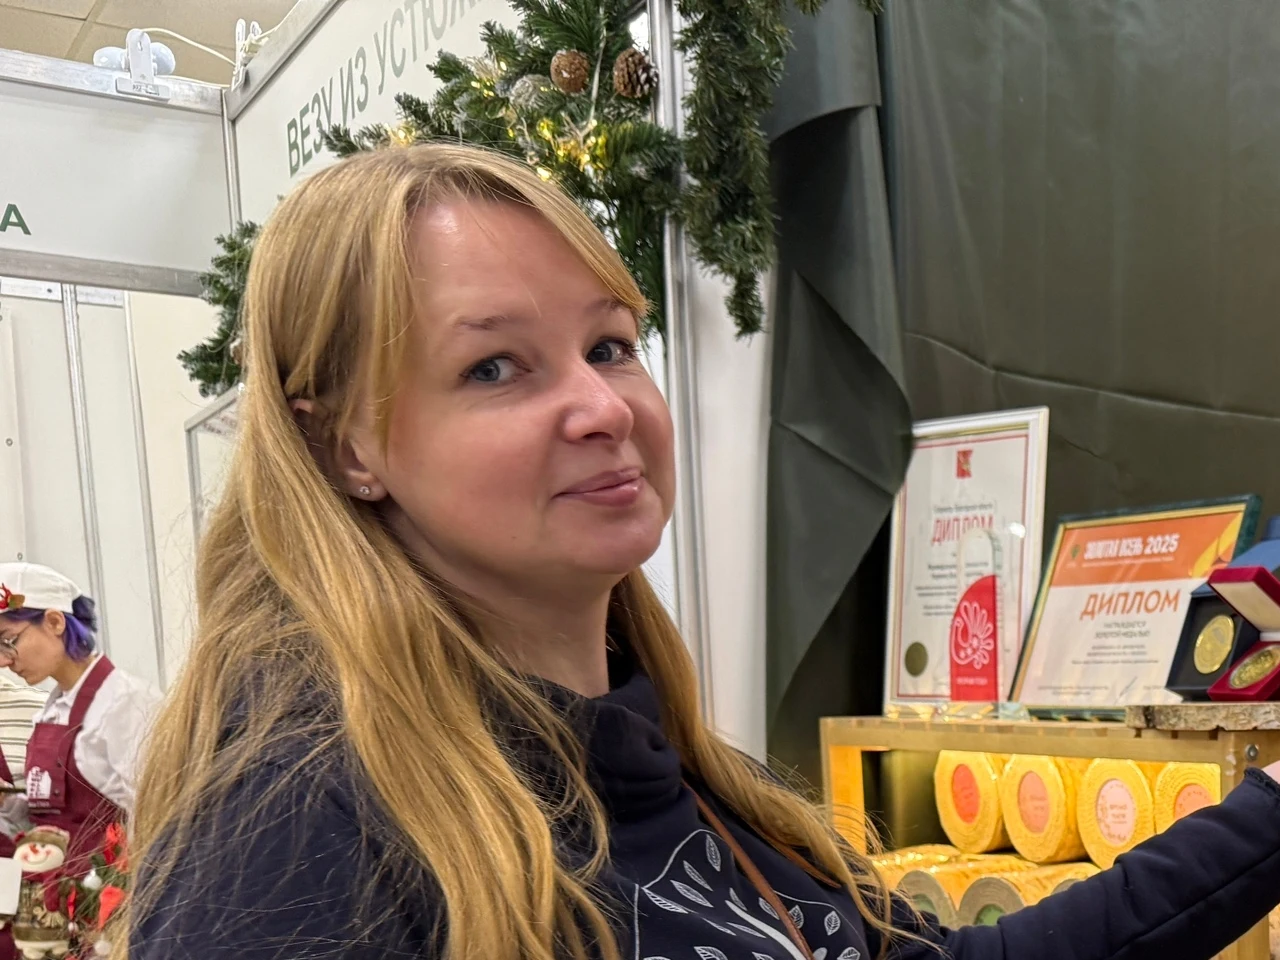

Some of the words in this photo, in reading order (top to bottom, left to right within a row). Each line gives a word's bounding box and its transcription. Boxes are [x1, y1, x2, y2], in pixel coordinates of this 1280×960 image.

[287, 76, 333, 178] ВЕЗУ
[340, 46, 369, 126] ИЗ
[1144, 533, 1180, 554] 2025
[1080, 589, 1181, 620] ДИПЛОМ
